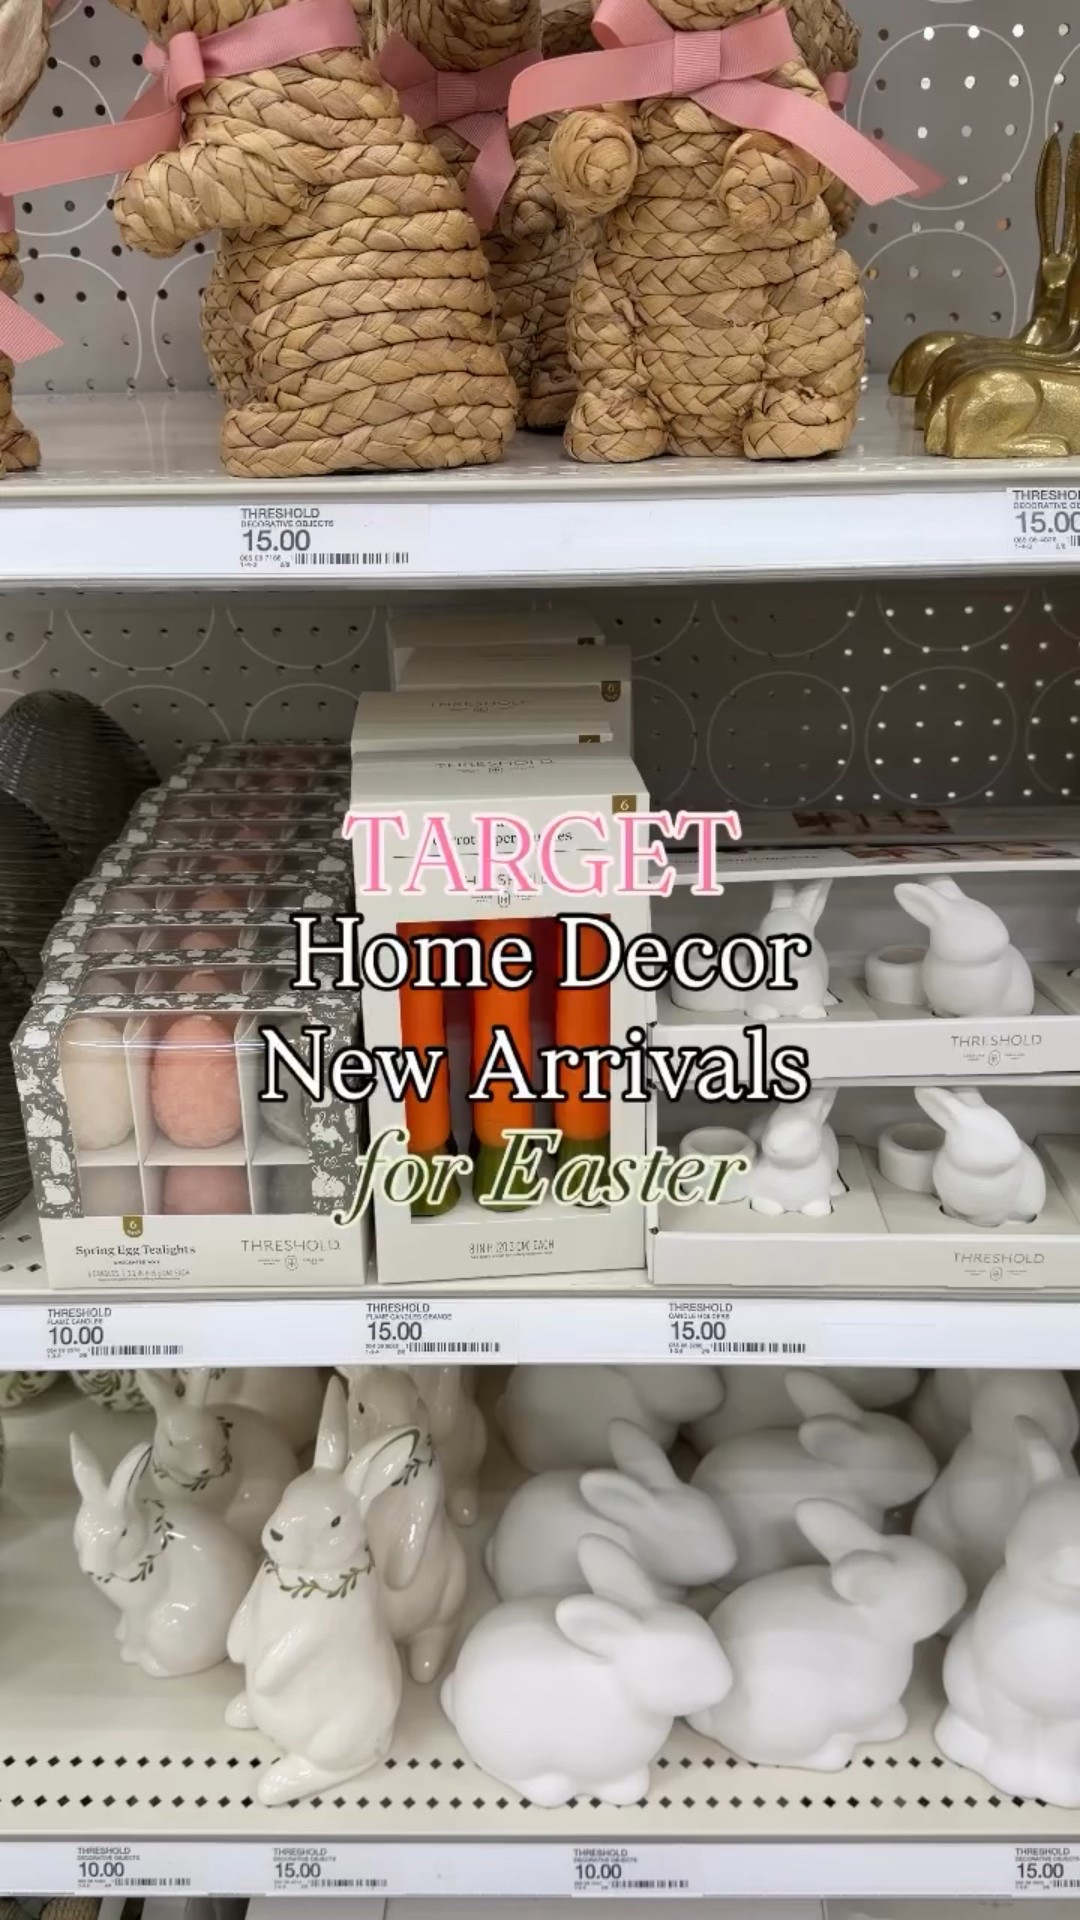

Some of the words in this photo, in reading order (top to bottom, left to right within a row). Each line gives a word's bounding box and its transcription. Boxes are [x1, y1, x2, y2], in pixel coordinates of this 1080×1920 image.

[240, 507, 320, 519] THRESHOLD
[242, 529, 311, 551] 15.00
[620, 799, 629, 811] 6
[951, 1034, 1042, 1047] THRESHOLD
[129, 1221, 137, 1229] 6
[75, 1245, 115, 1257] Spring
[117, 1245, 140, 1256] Egg
[142, 1244, 196, 1256] Tealights
[241, 1240, 340, 1252] THRESHOLD
[953, 1251, 1045, 1264] THRESHOLD
[48, 1308, 112, 1318] THRESHOLD
[366, 1303, 430, 1313] THRESHOLD
[668, 1302, 733, 1312] THRESHOLD
[49, 1326, 104, 1345] 10.00
[368, 1321, 422, 1341] 15.00
[671, 1321, 727, 1340] 15.00
[78, 1847, 131, 1855] THRESHOLD
[273, 1848, 327, 1856] THRESHOLD
[573, 1848, 628, 1857] THRESHOLD
[1015, 1847, 1070, 1856] THRESHOLD
[79, 1862, 125, 1877] 10.00
[275, 1862, 321, 1878] 15.00
[575, 1863, 622, 1879] 10.00
[1017, 1862, 1064, 1878] 15.00
